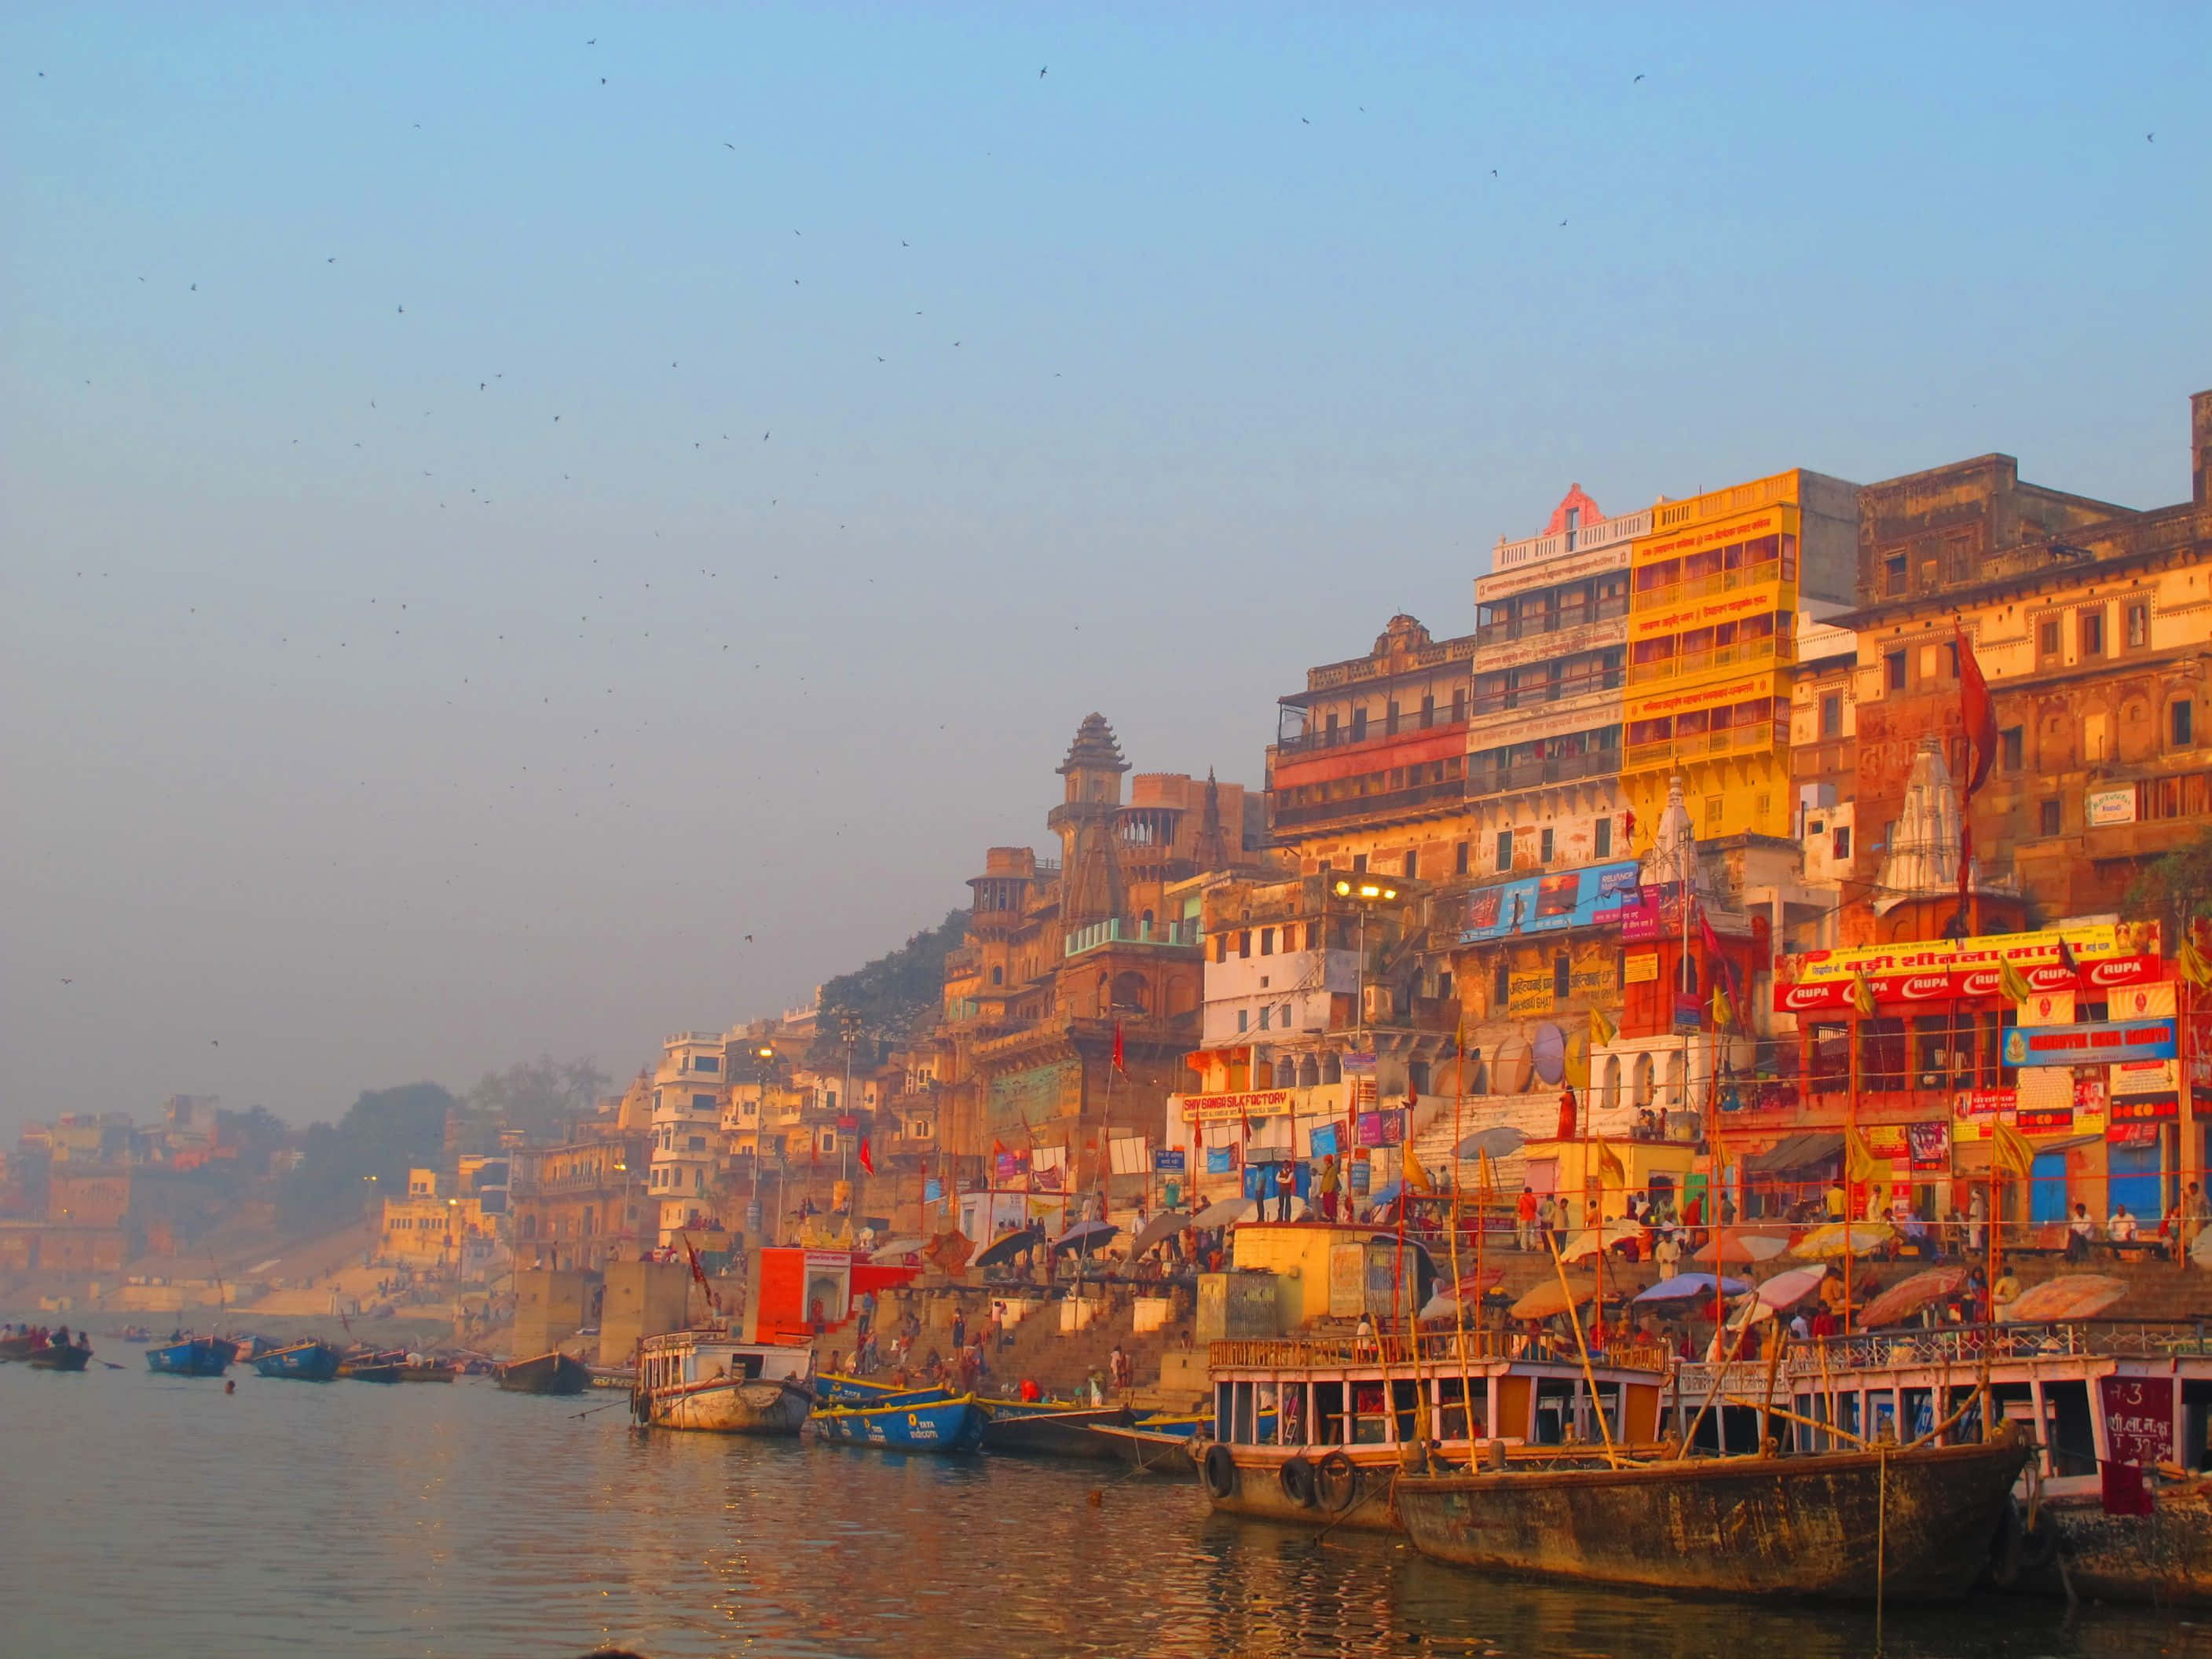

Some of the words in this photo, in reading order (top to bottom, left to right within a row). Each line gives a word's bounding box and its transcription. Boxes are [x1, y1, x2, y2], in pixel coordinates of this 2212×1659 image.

[1844, 955, 1895, 972] बड़ी
[1901, 950, 2001, 967] शीतला
[2104, 961, 2141, 974] RUPA
[1914, 978, 1949, 989] RUPA
[1796, 987, 1829, 999] RUPA
[1536, 995, 1553, 1009] GHAT
[1184, 1098, 1200, 1111] SHIV
[1201, 1097, 1227, 1109] GANGA
[1227, 1094, 1245, 1108] SILK
[1245, 1091, 1287, 1107] FACTORY
[919, 1420, 936, 1429] TATA
